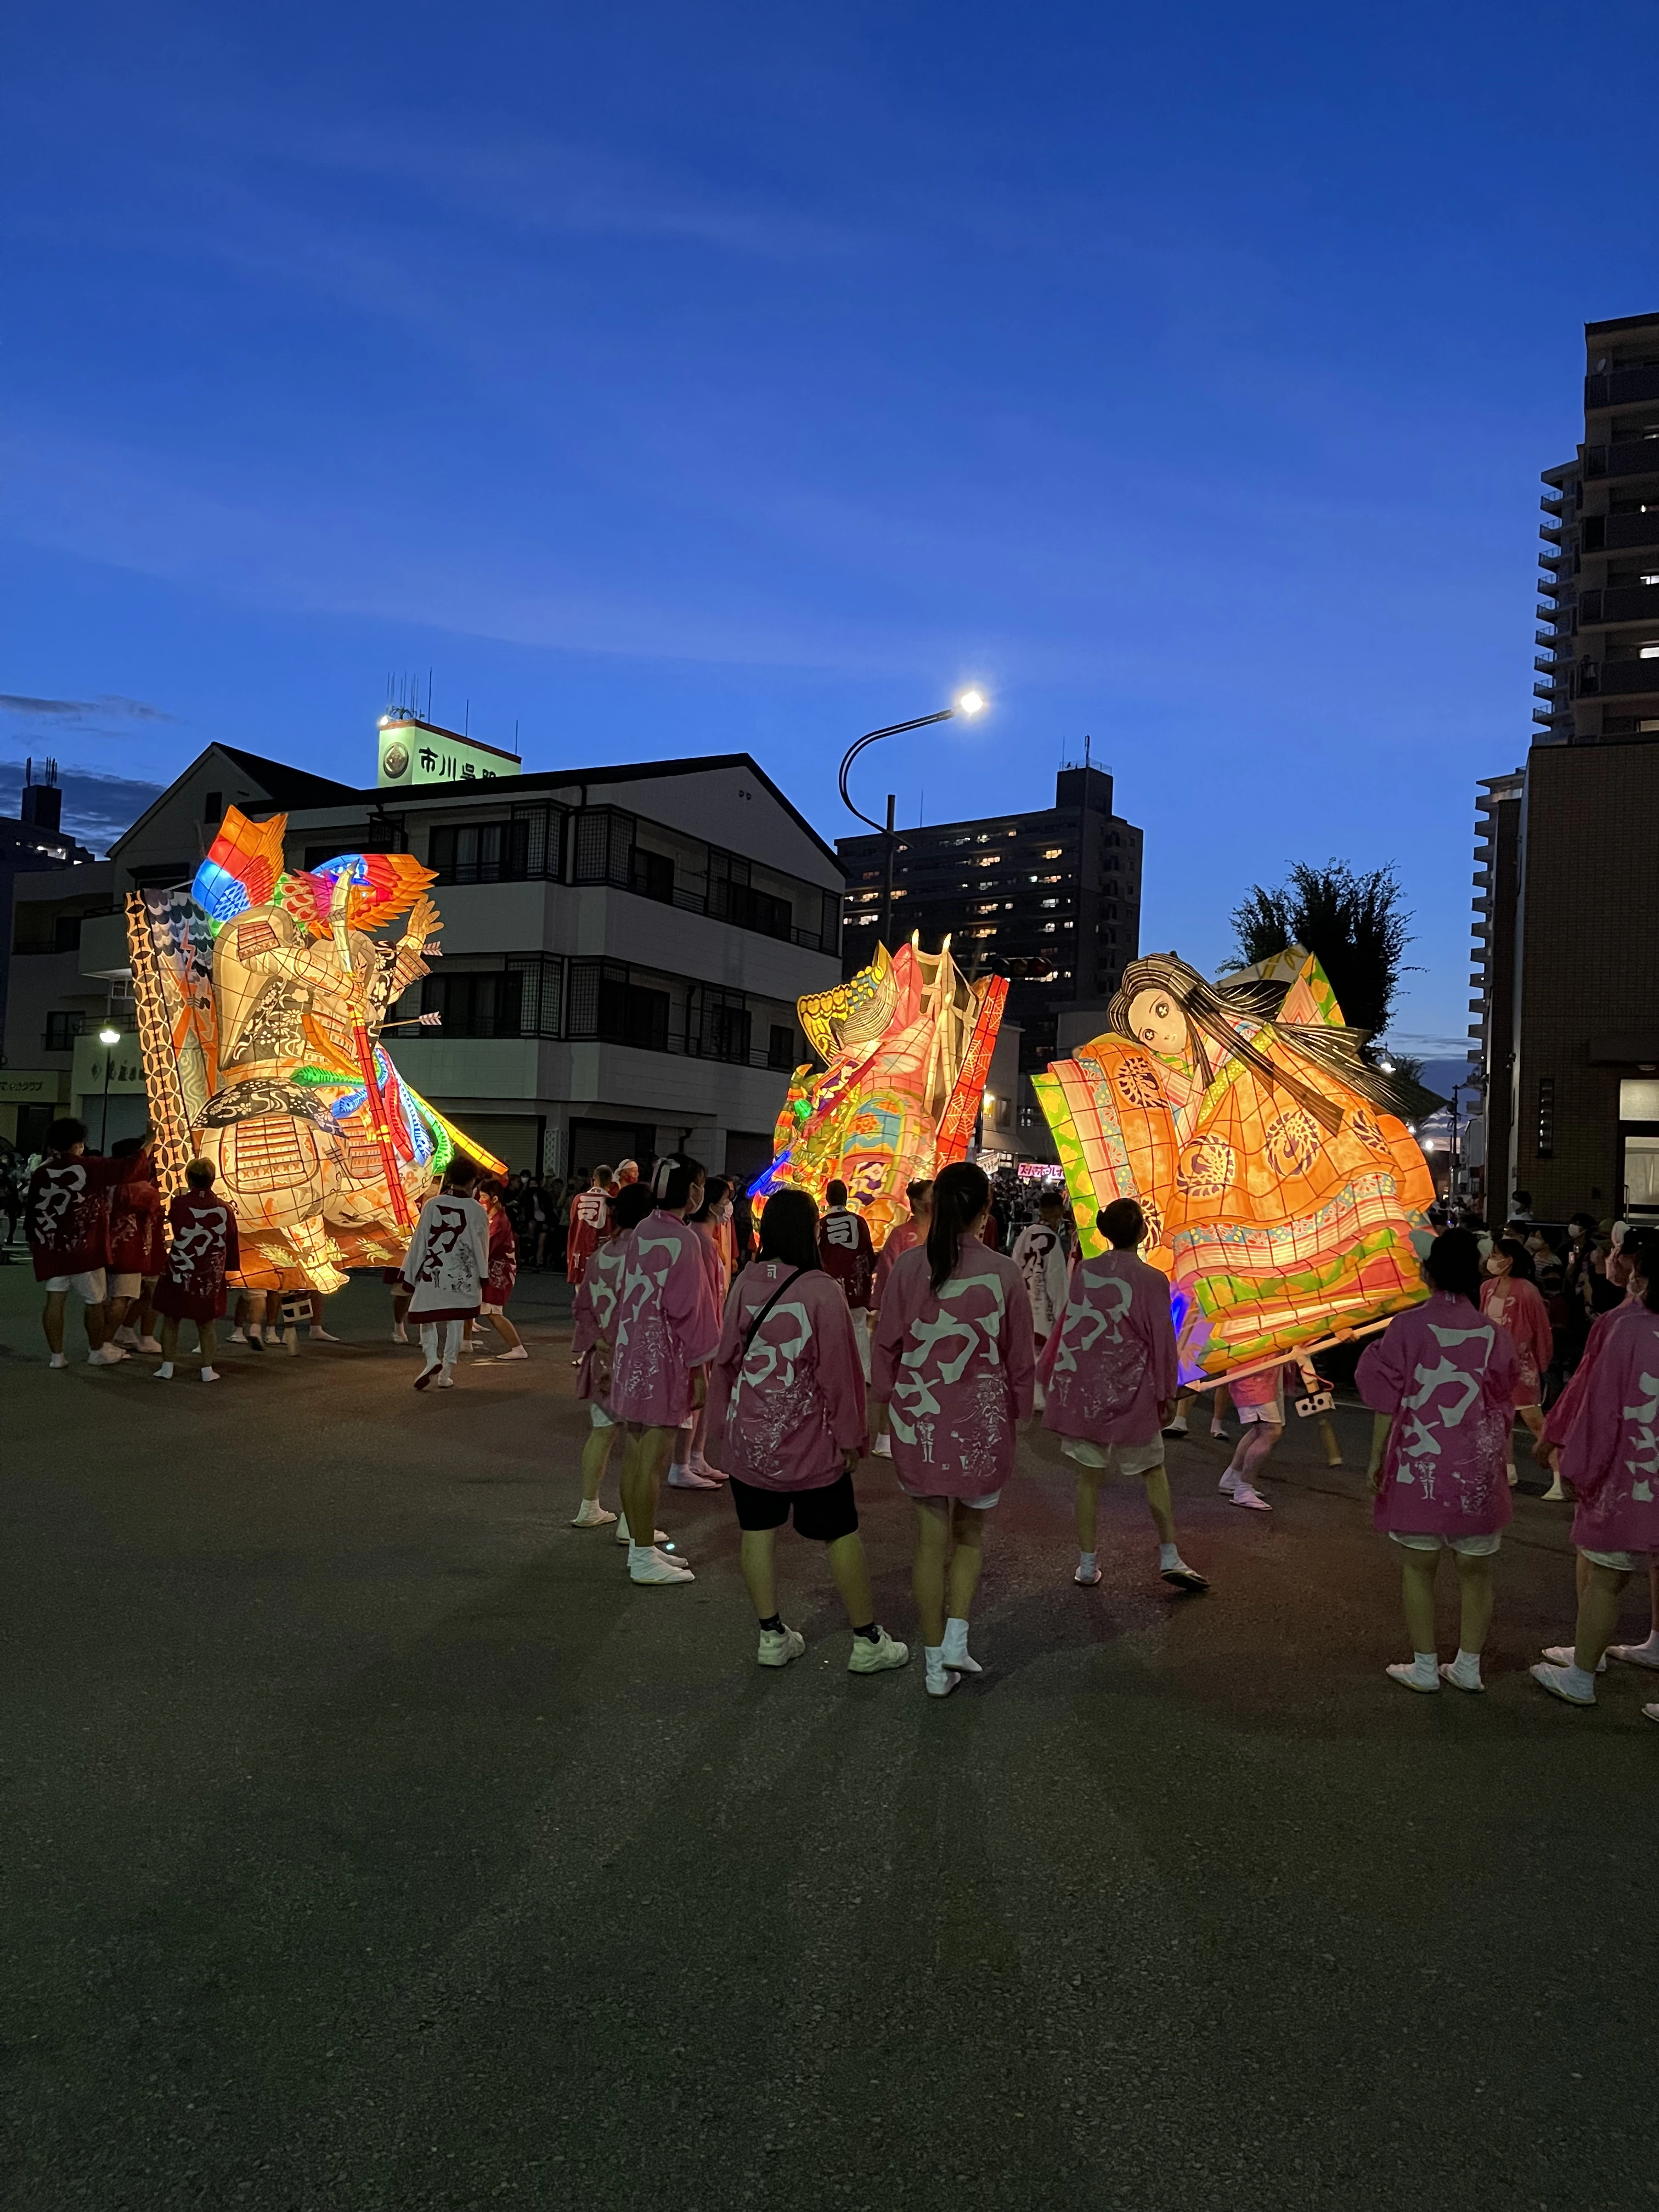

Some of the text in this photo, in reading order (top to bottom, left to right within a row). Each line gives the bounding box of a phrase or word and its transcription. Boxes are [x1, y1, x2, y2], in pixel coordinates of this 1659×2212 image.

[35, 1164, 87, 1244] つかさ
[577, 1195, 607, 1229] 司
[827, 1215, 859, 1250] 司
[172, 1206, 227, 1283] つかさ
[767, 1264, 777, 1279] 司
[889, 1273, 1005, 1445] つかさ
[1397, 1324, 1495, 1484] つかさ
